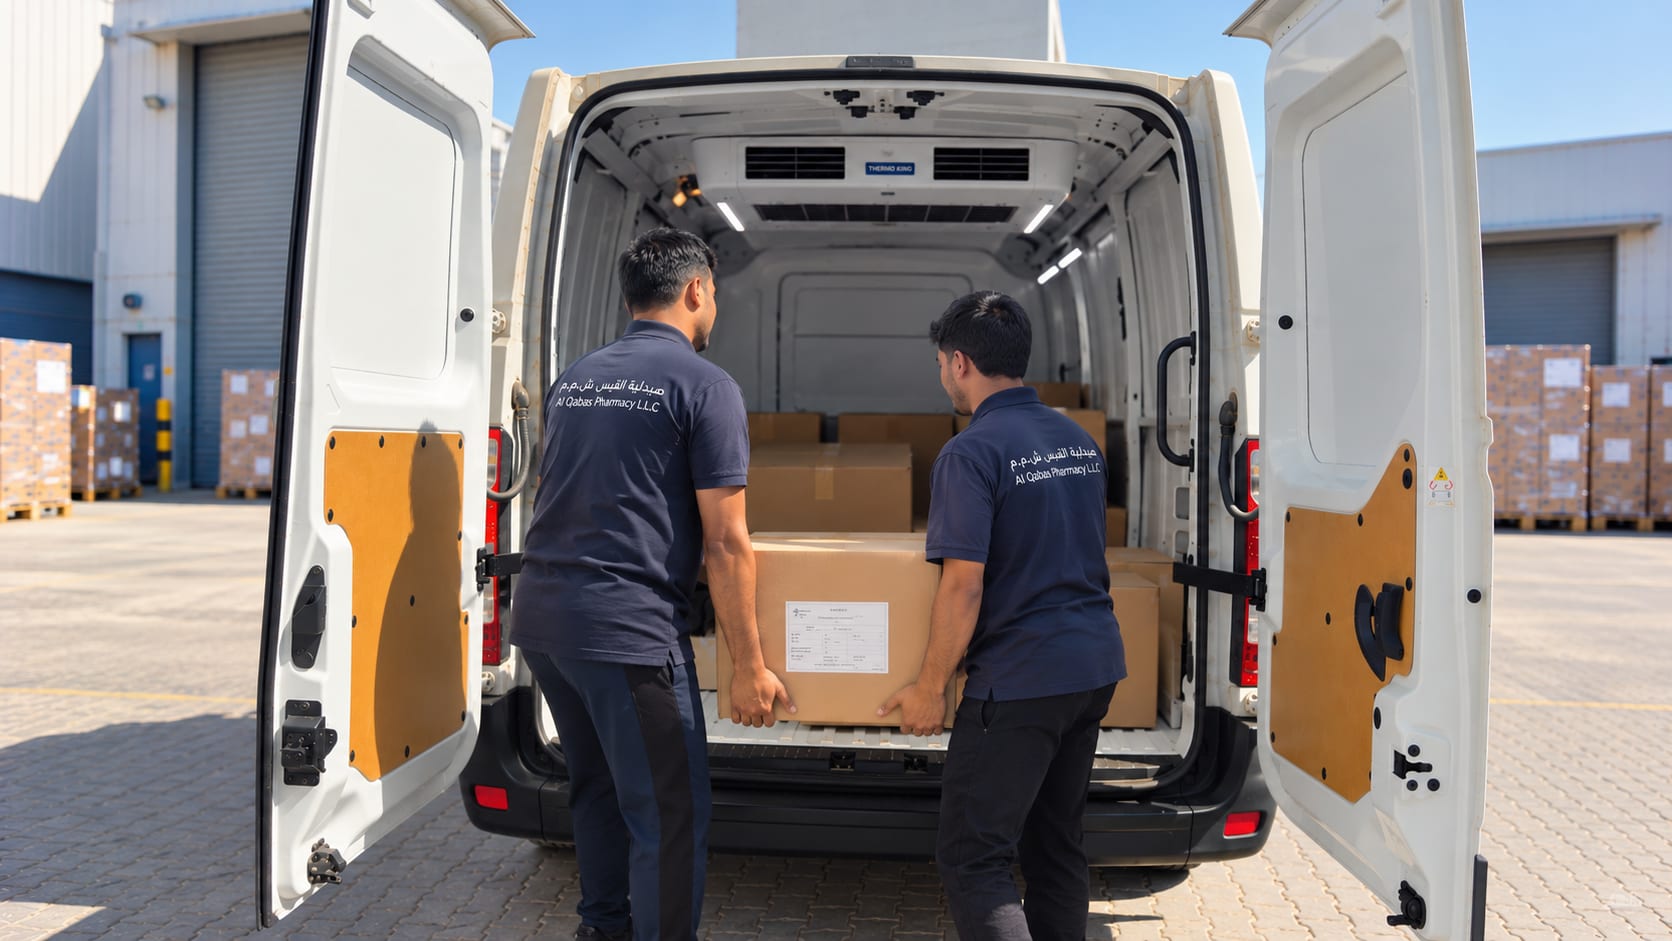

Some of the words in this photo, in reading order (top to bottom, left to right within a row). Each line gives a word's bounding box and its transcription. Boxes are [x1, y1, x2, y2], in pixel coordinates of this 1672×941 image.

[628, 379, 665, 396] صيدلية
[555, 397, 565, 407] Al
[565, 396, 593, 408] Qabas
[594, 396, 635, 411] Pharmacy
[637, 399, 661, 413] L.L.C
[1015, 473, 1026, 486] Al
[1026, 470, 1052, 483] Qabas
[1050, 466, 1087, 478] Pharmacy
